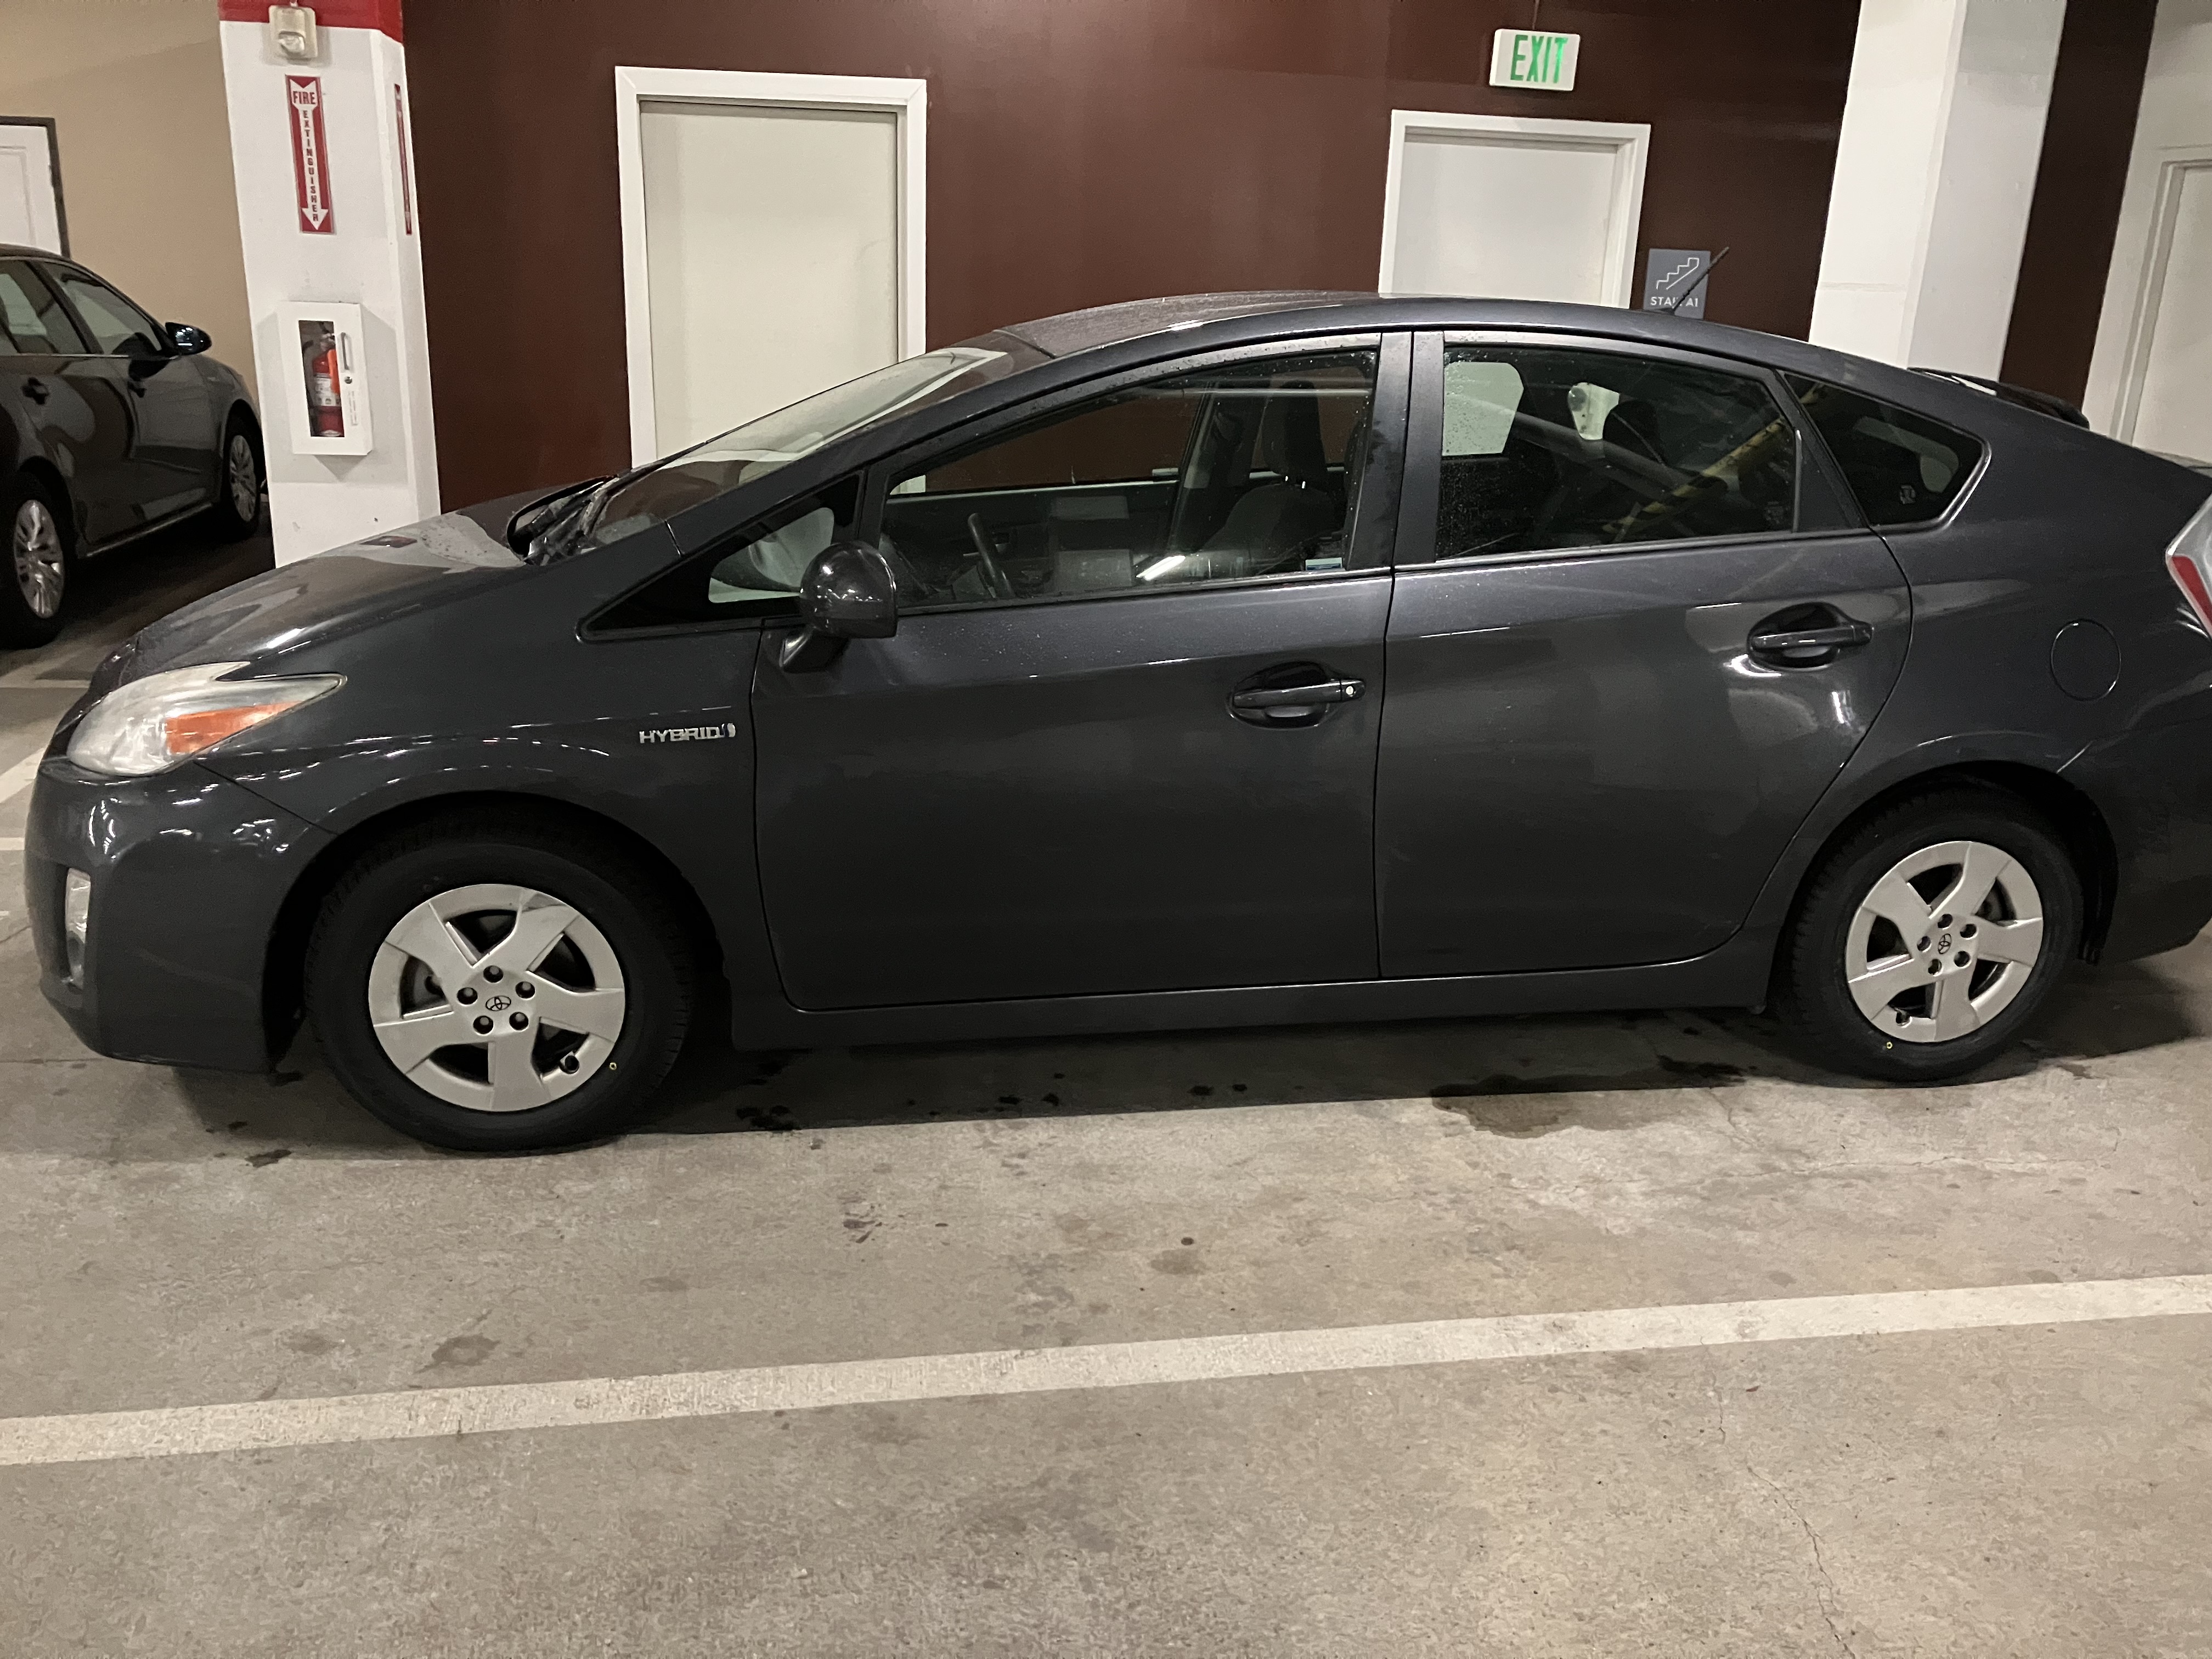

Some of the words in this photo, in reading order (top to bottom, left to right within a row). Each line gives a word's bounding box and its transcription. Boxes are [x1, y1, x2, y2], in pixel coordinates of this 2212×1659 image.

[1510, 35, 1568, 83] EXIT
[292, 91, 316, 104] FIRE
[303, 110, 318, 222] EXTINGUISHER
[1650, 296, 1682, 306] STAI
[639, 726, 725, 743] HYBRID
